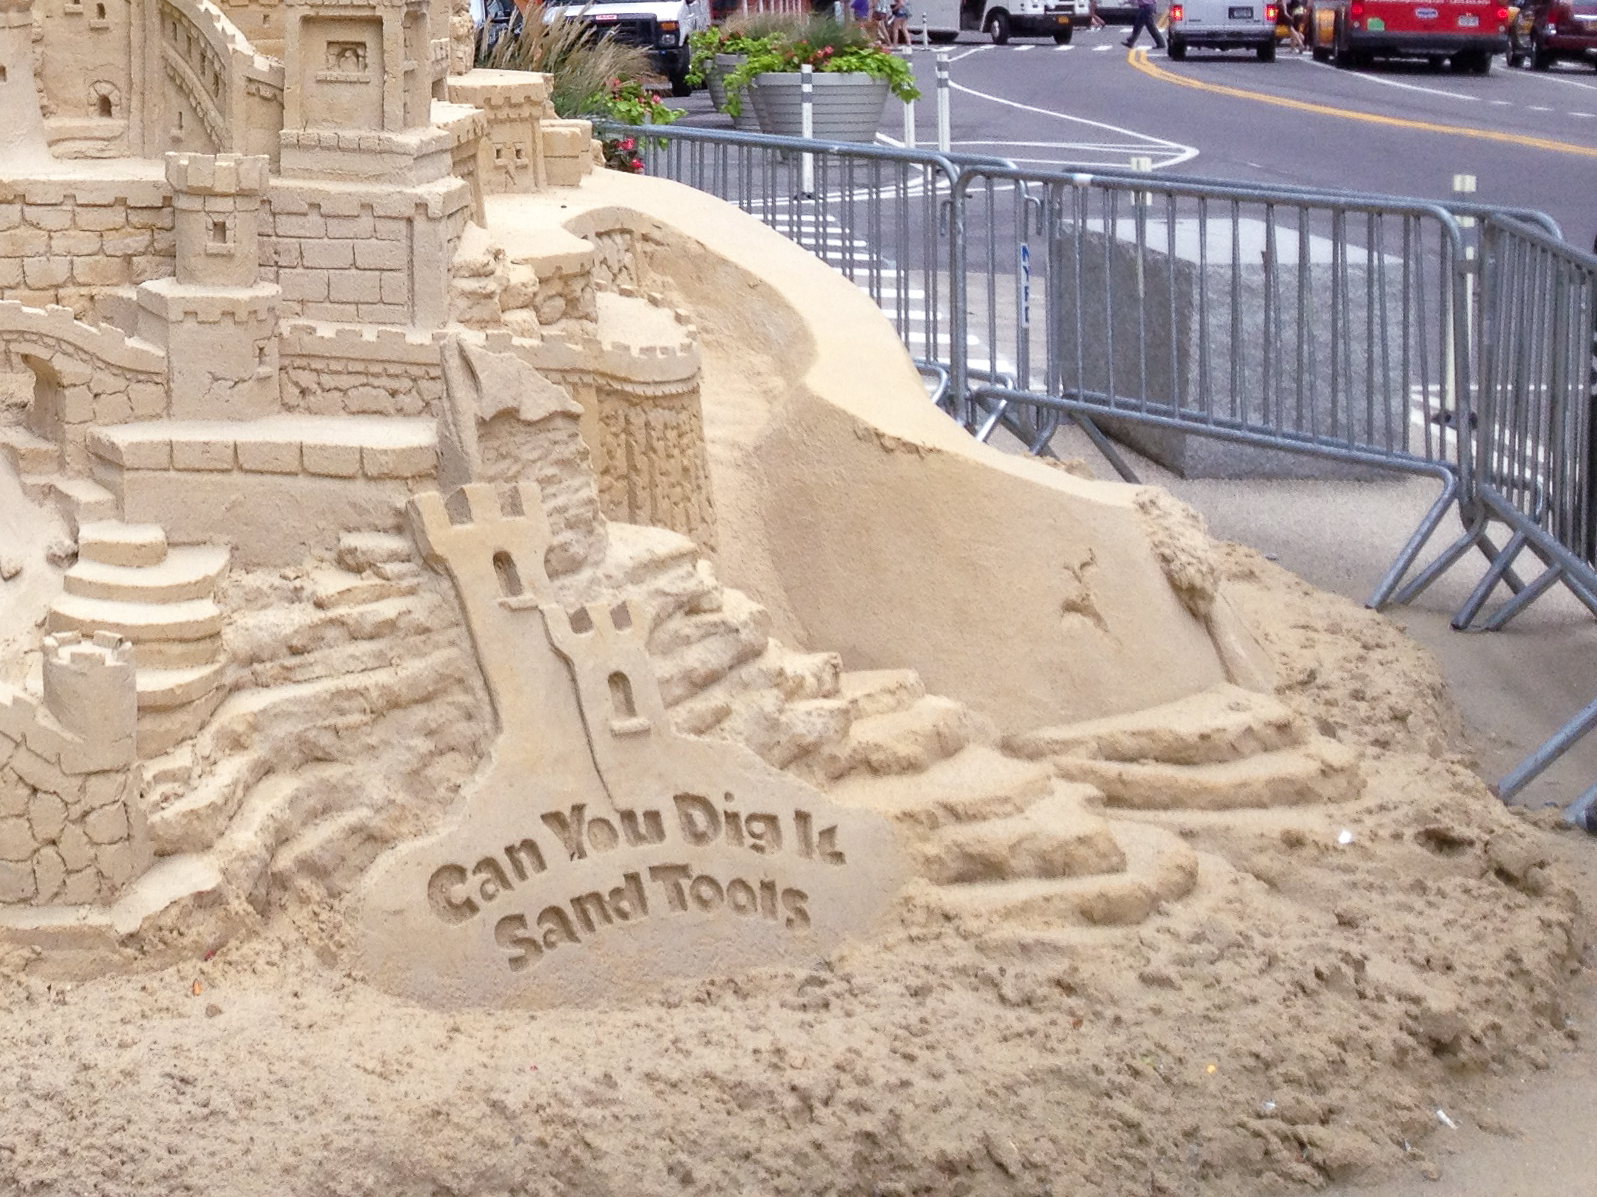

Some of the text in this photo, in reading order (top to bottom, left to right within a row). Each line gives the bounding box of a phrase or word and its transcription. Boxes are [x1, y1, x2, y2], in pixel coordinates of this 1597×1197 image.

[426, 790, 847, 925] Can You Dig It
[493, 862, 811, 973] Sand Tools
